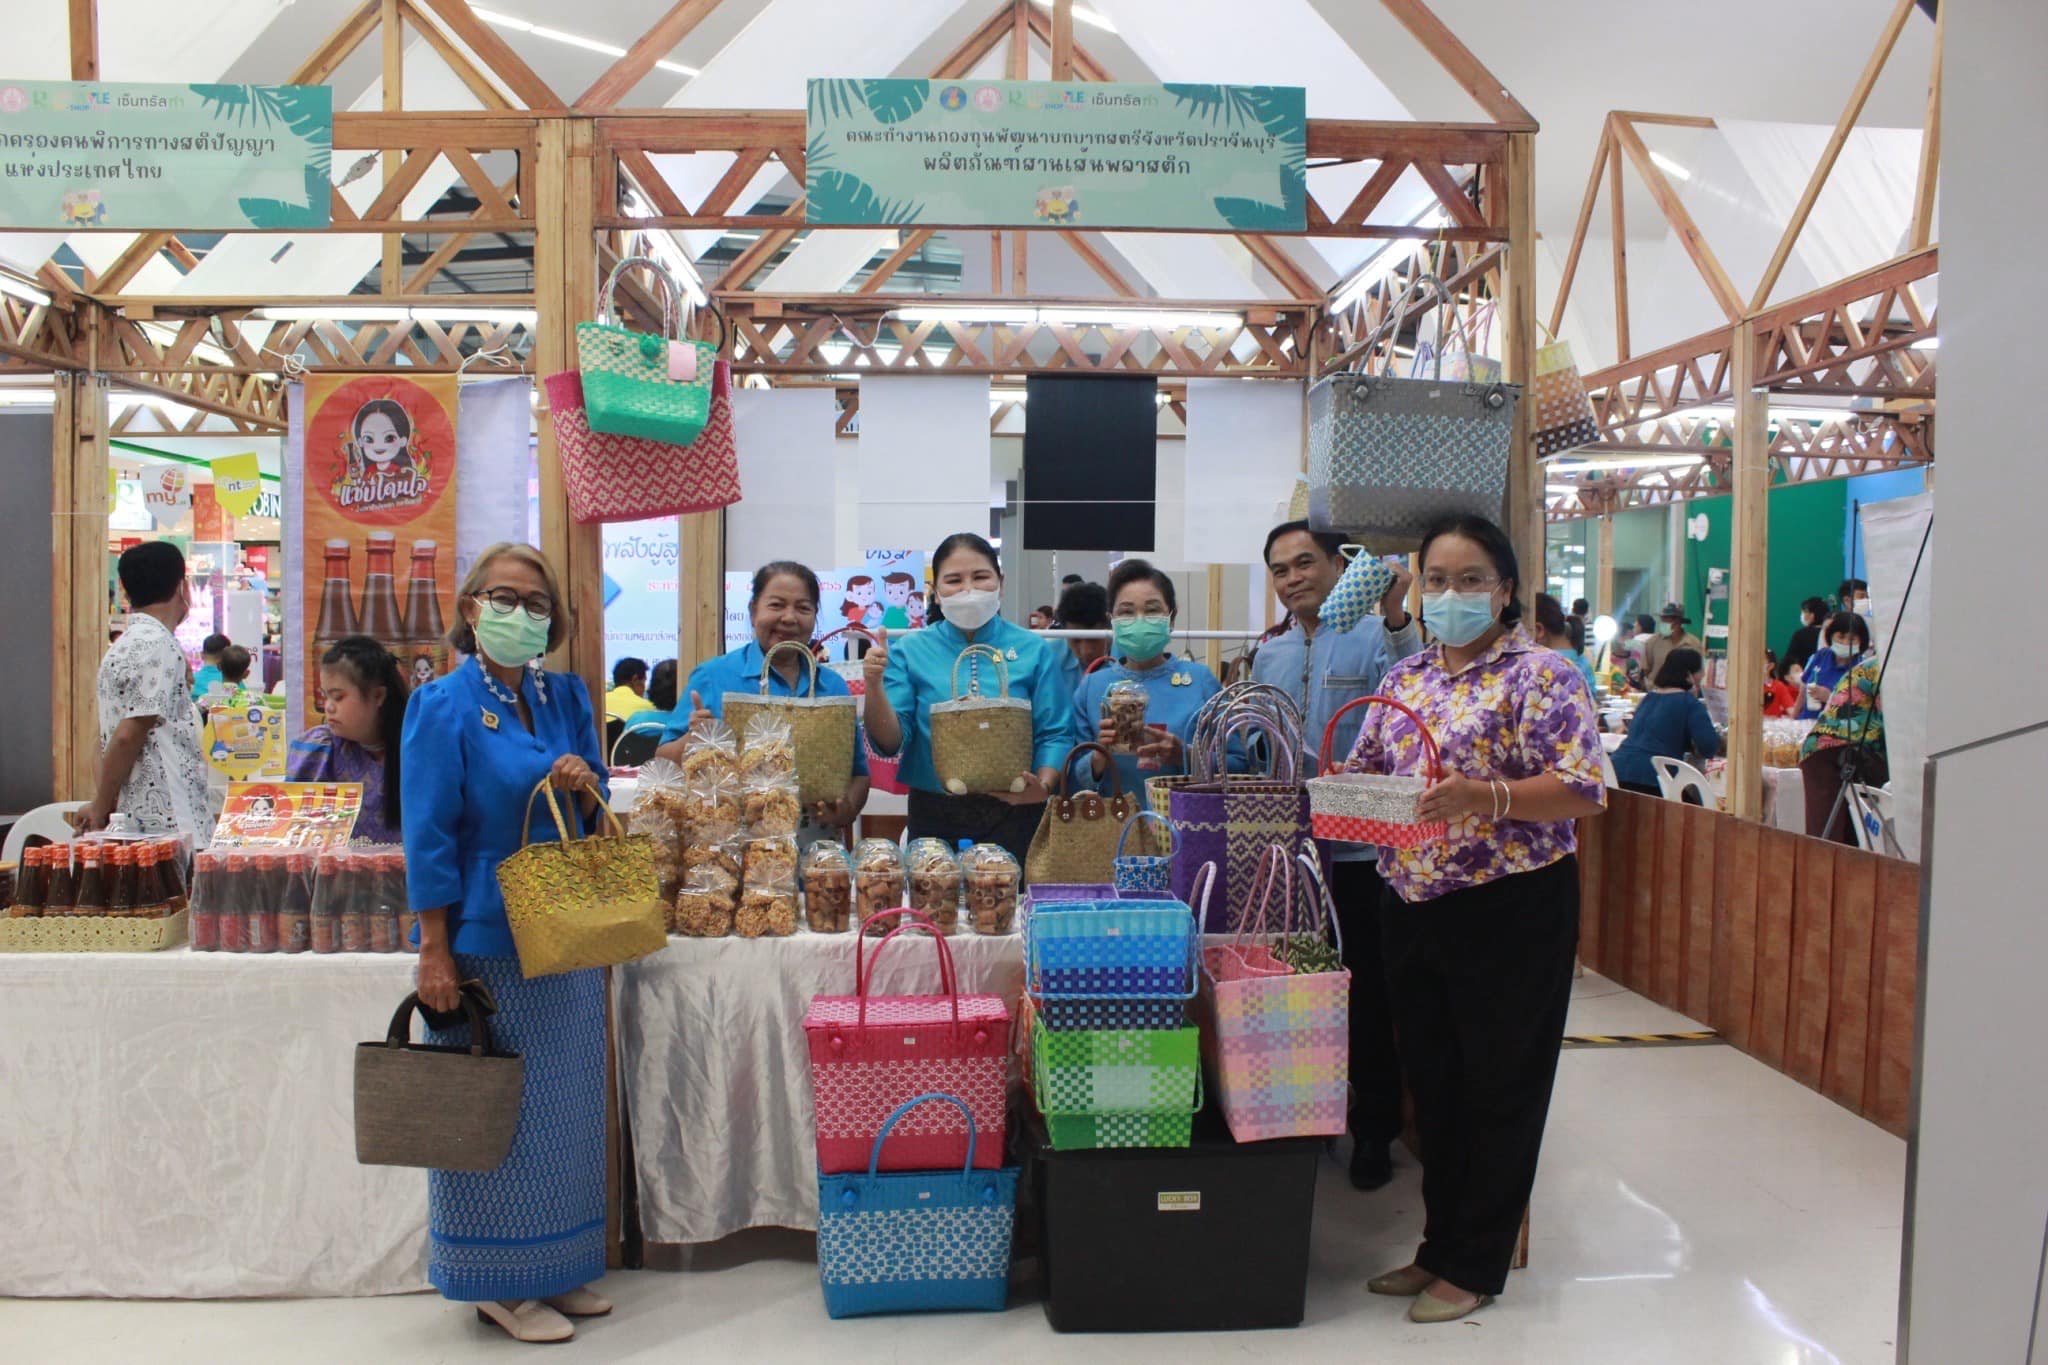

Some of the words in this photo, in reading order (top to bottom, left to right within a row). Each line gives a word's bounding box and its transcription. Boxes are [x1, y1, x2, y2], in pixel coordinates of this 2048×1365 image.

[5, 151, 162, 179] แห่งประเทศไทย
[924, 145, 1191, 174] ผลิตภัณฑ์สานเส้นพลาสติก
[247, 492, 280, 518] OBIN
